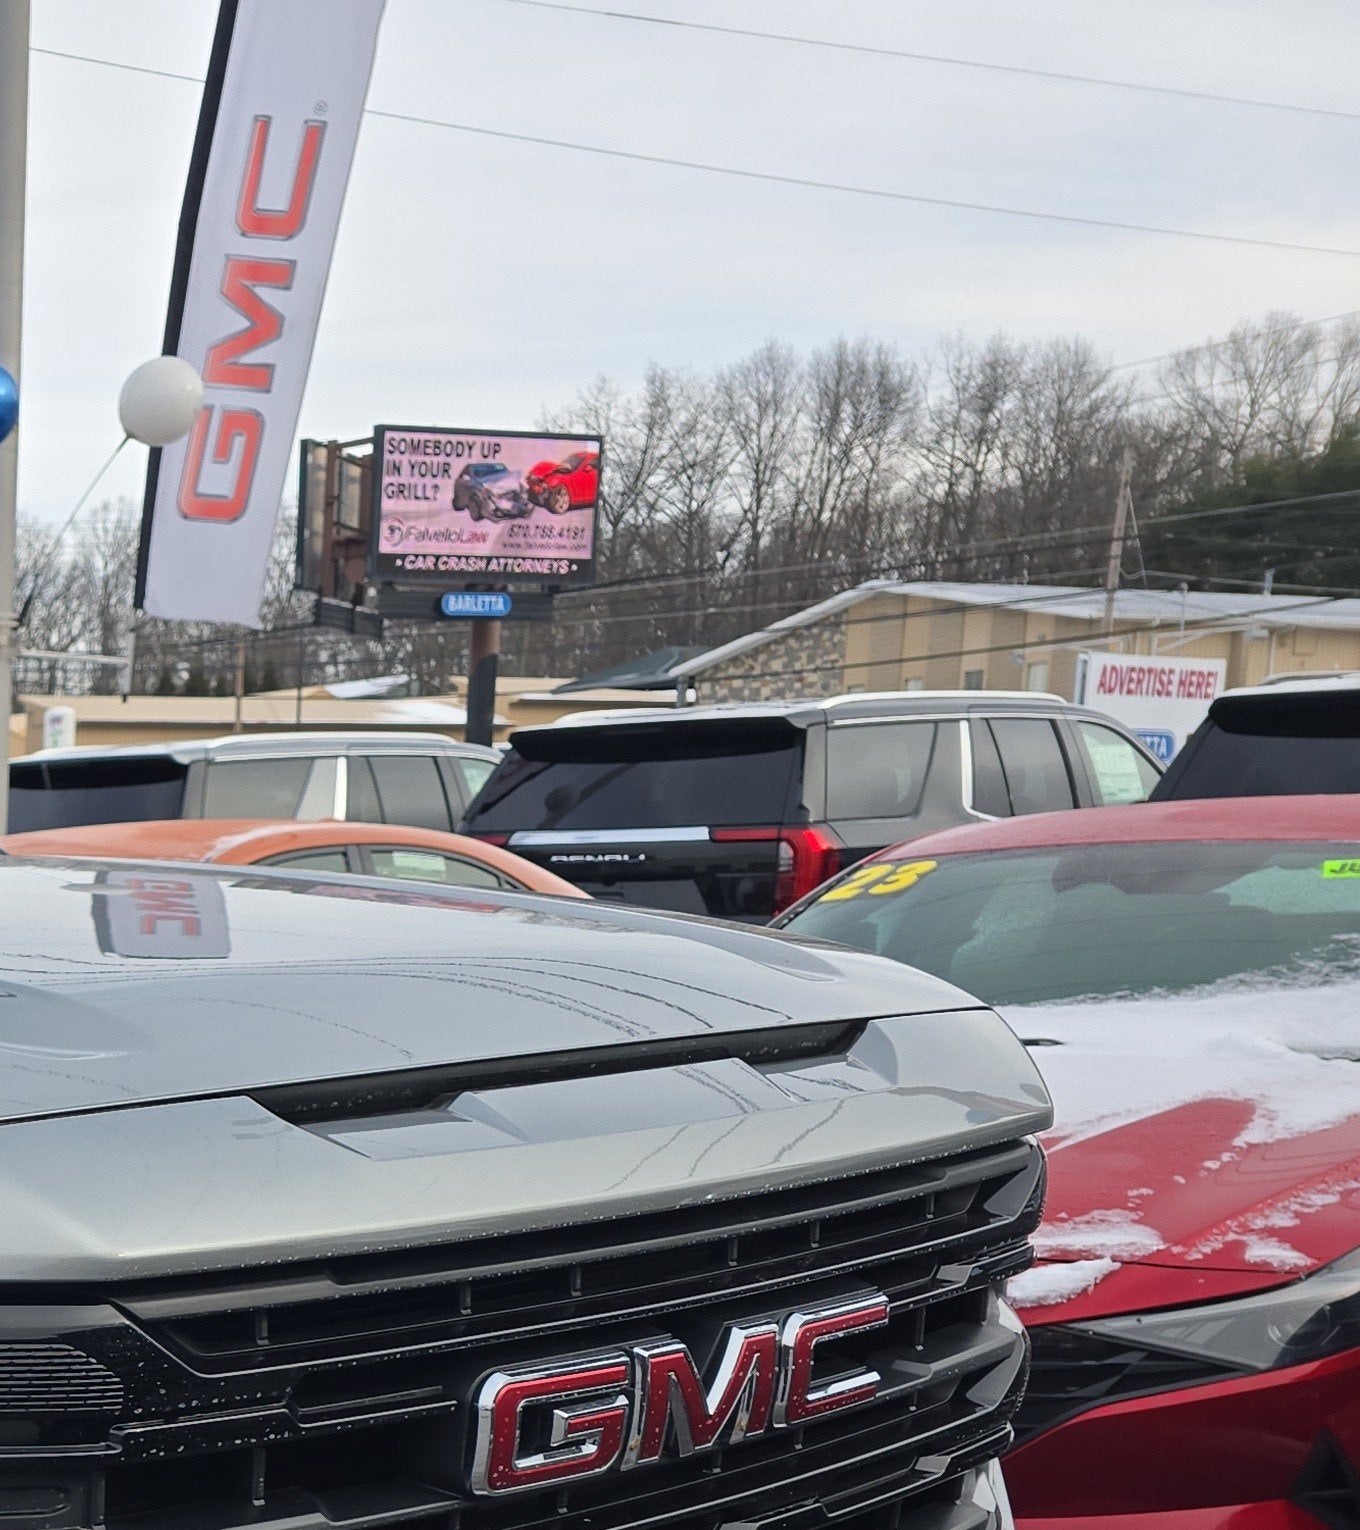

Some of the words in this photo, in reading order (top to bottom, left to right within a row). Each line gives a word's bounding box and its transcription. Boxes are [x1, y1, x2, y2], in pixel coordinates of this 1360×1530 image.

[177, 114, 327, 523] GMC
[387, 437, 475, 458] SOMEBODY
[481, 441, 501, 459] UP
[386, 459, 401, 476] IN
[409, 460, 451, 479] YOUR
[385, 482, 440, 500] GRILL?
[404, 555, 436, 571] CAR
[437, 556, 487, 572] CRASH
[487, 558, 570, 575] ATTORNEYS
[1097, 664, 1175, 698] ADVERTISE
[1176, 668, 1218, 700] HERE!
[818, 859, 938, 902] 23
[471, 1293, 889, 1496] GMC
